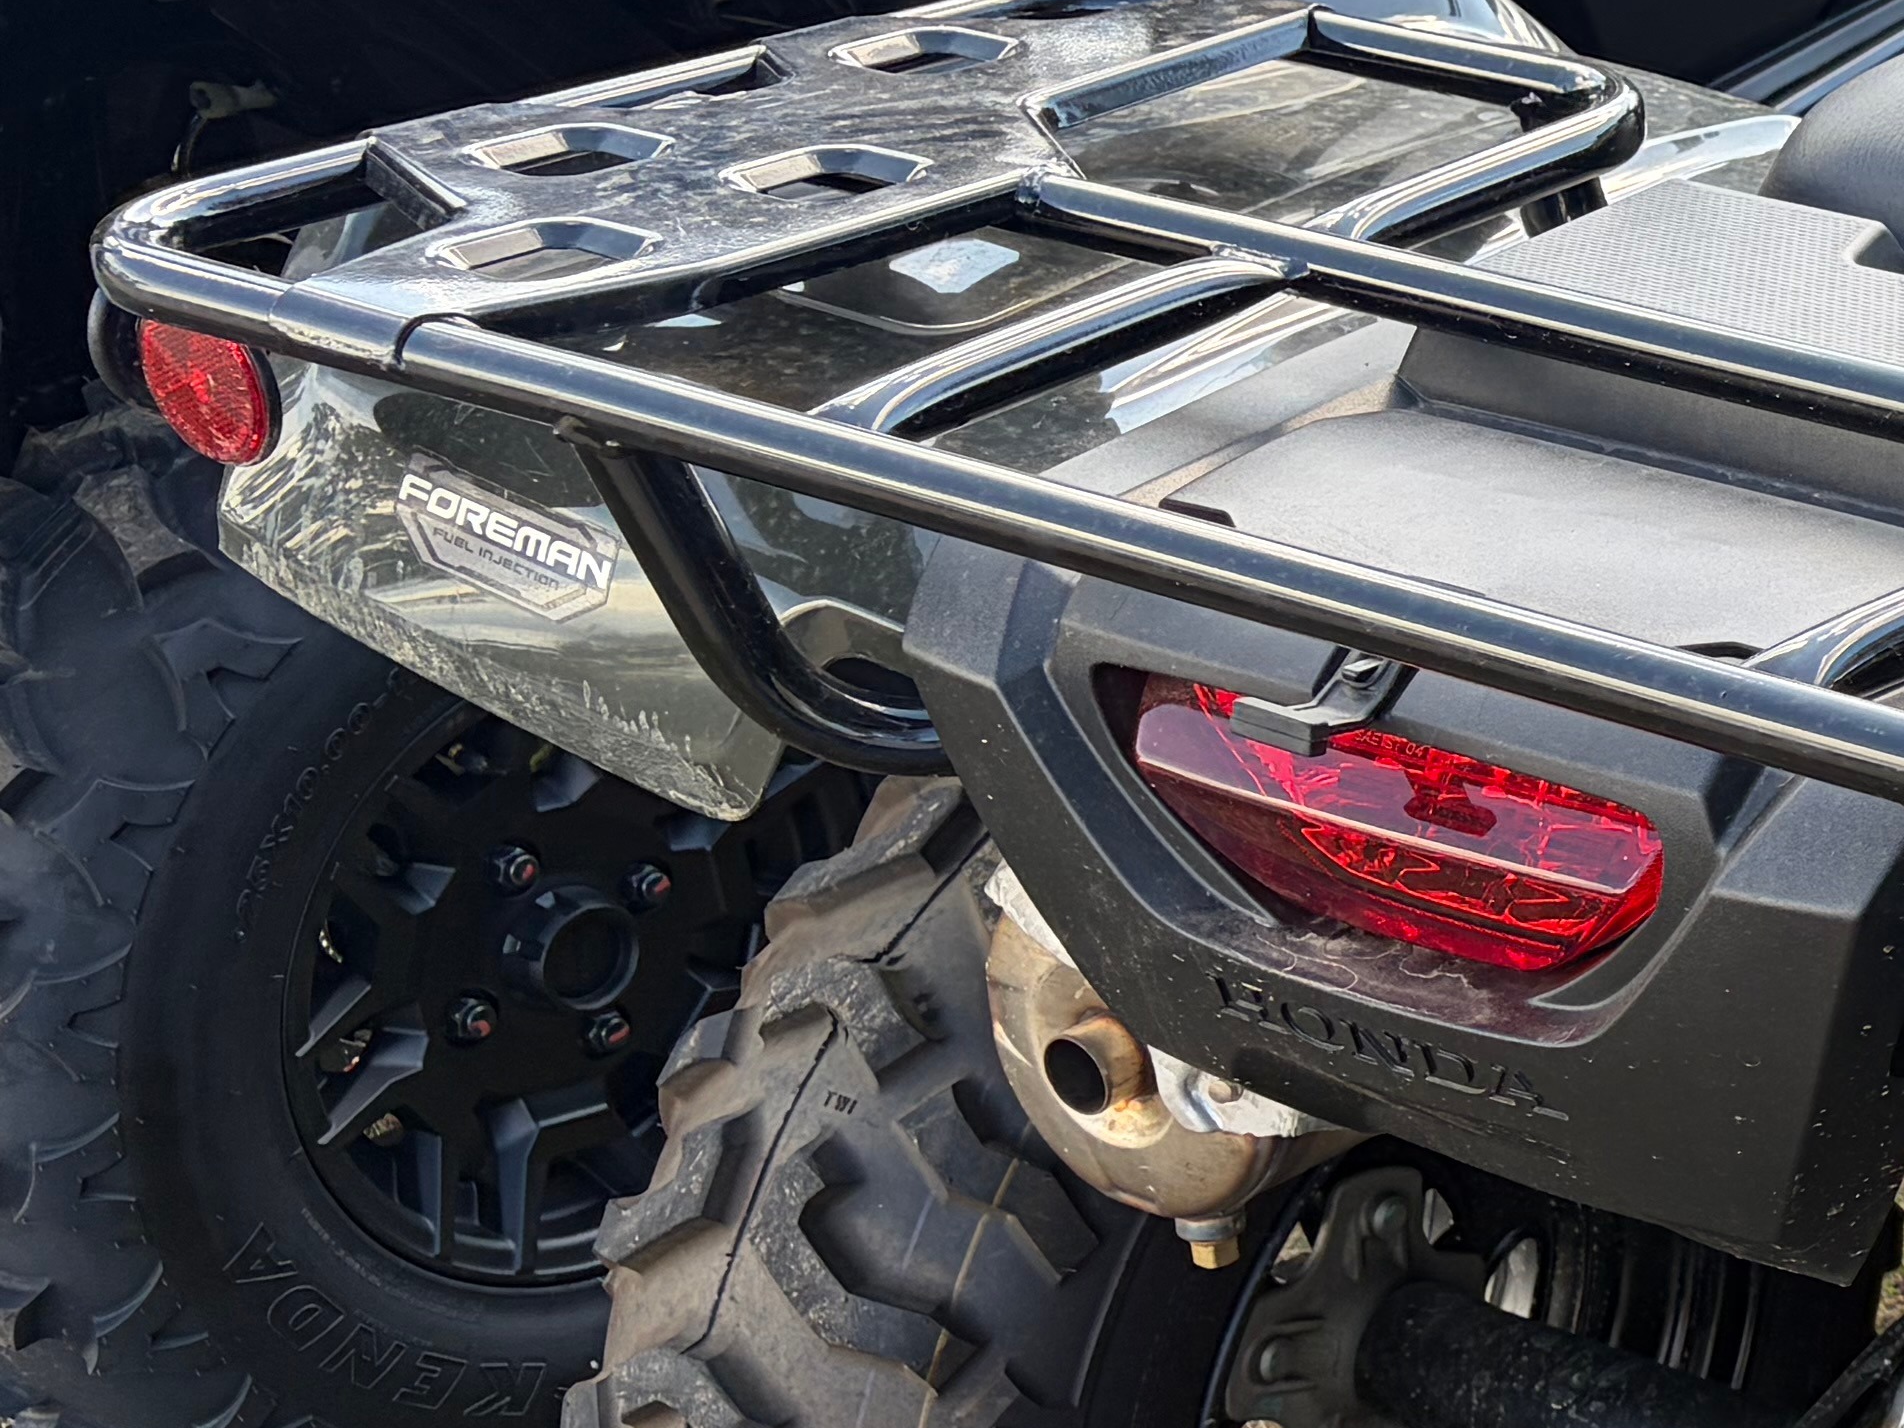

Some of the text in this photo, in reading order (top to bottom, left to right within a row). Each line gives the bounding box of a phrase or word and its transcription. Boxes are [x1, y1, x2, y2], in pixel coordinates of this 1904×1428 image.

[399, 473, 614, 588] FOREMAN
[433, 527, 560, 591] FUEL INJECTION
[1205, 968, 1570, 1121] HONDA
[823, 1089, 858, 1116] TWI
[222, 1220, 547, 1417] KENDA
